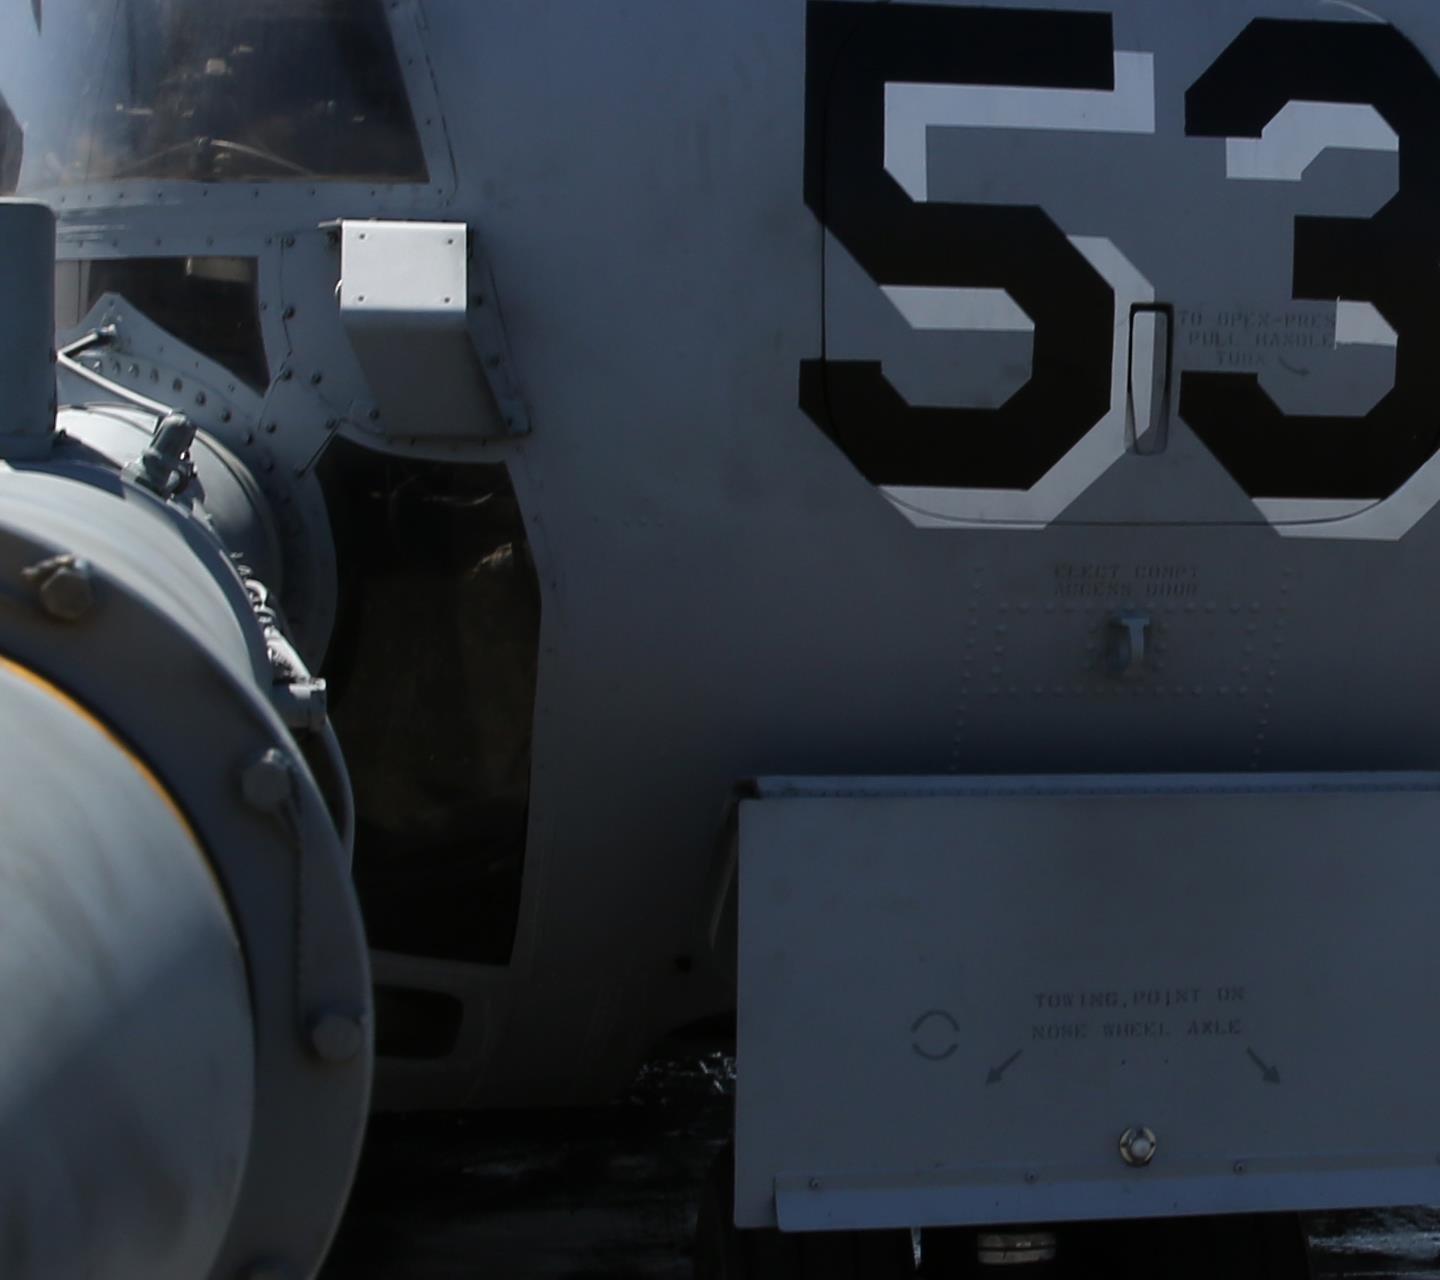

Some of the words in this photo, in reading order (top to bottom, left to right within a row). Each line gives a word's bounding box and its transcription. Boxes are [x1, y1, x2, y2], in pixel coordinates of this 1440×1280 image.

[1215, 984, 1248, 1003] ON
[1102, 1020, 1172, 1040] WHEEL
[1186, 1017, 1243, 1037] AXLE
